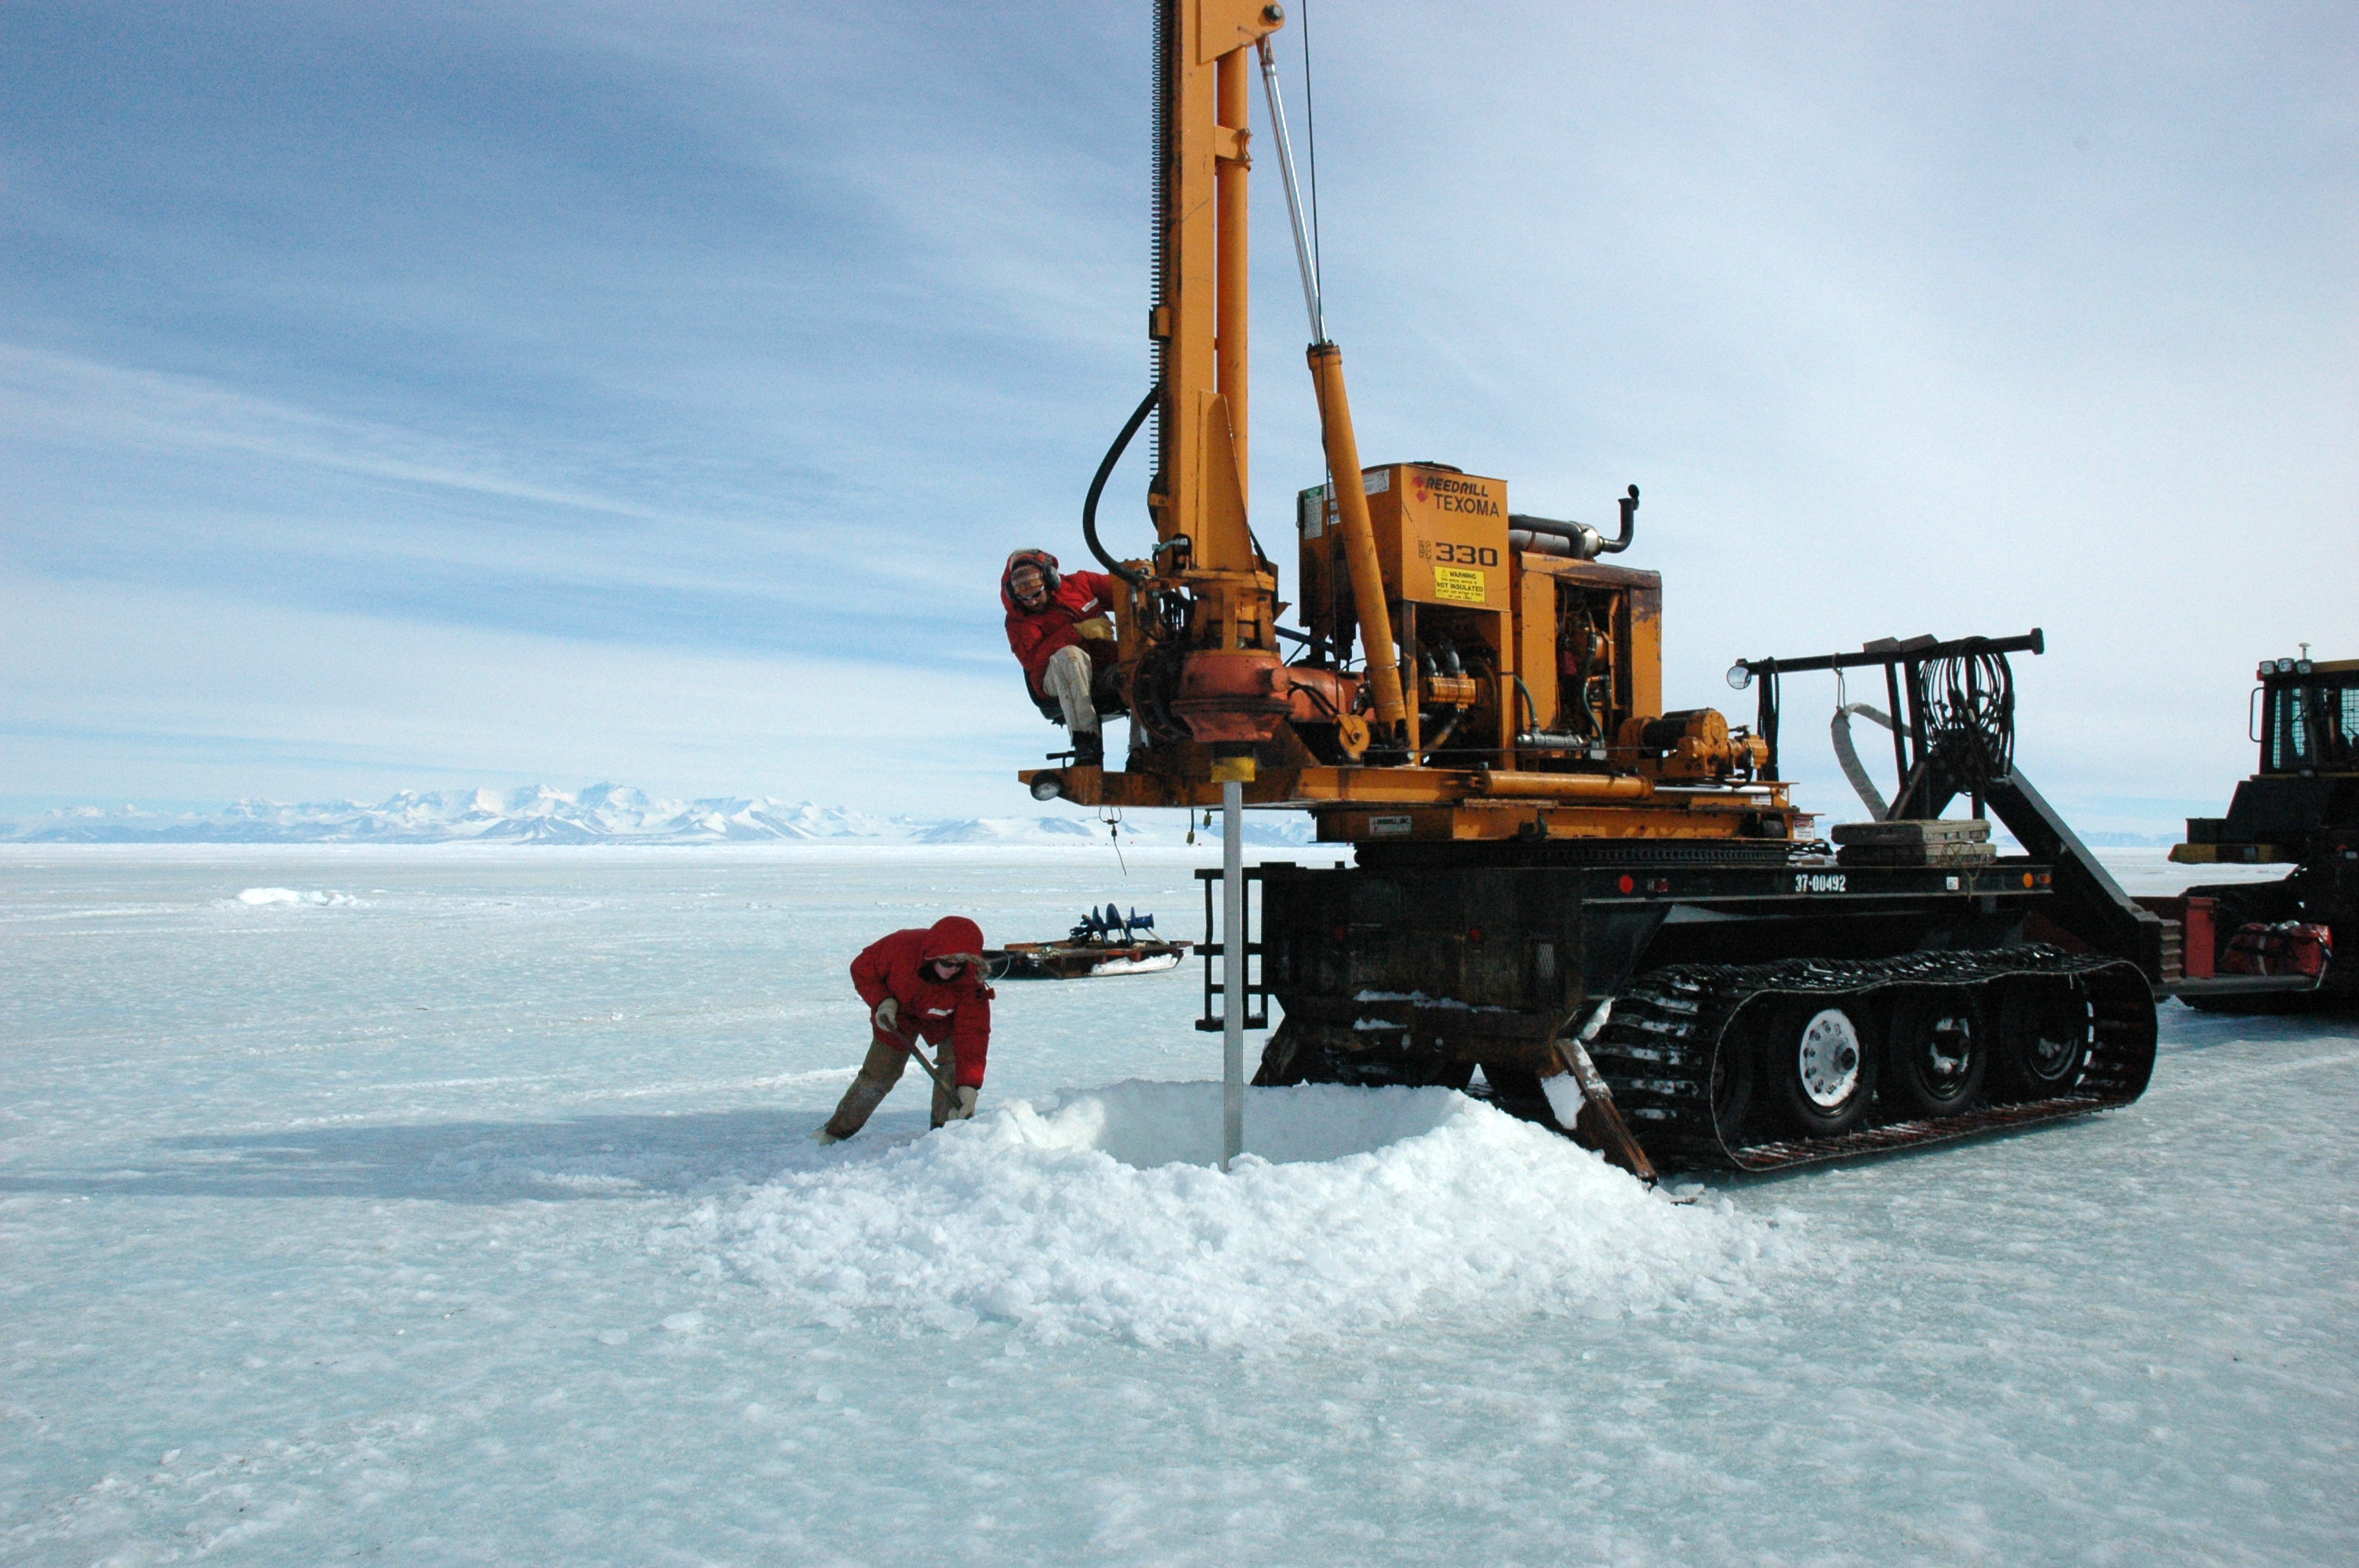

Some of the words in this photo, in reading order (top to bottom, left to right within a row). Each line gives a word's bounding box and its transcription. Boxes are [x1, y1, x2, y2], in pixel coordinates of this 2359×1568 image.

[1426, 476, 1488, 497] REEDRILL
[1434, 492, 1499, 517] TEXOMA
[1435, 542, 1498, 567] 330
